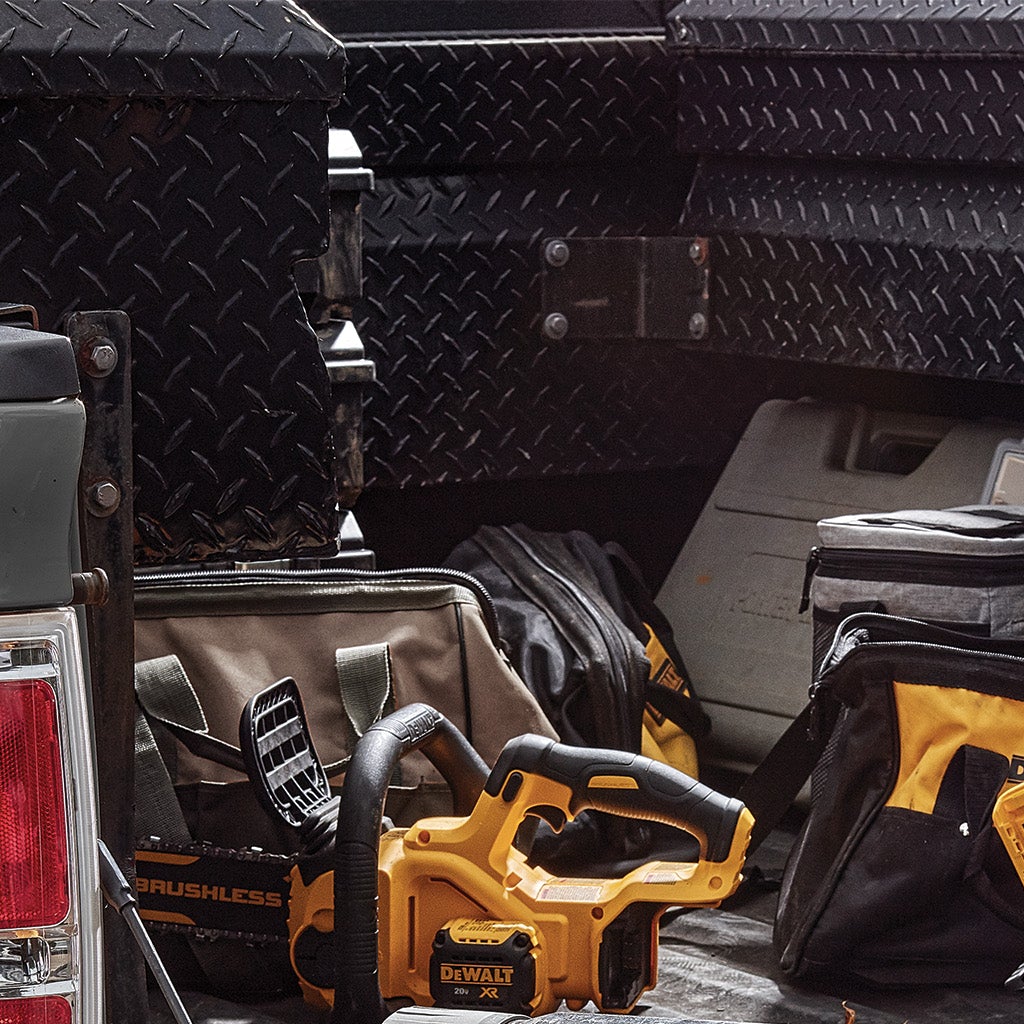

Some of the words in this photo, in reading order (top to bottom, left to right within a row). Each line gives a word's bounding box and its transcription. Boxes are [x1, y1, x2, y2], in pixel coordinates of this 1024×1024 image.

[136, 878, 281, 907] BRUSHLESS
[440, 965, 514, 984] DEWALT
[479, 987, 499, 999] XR
